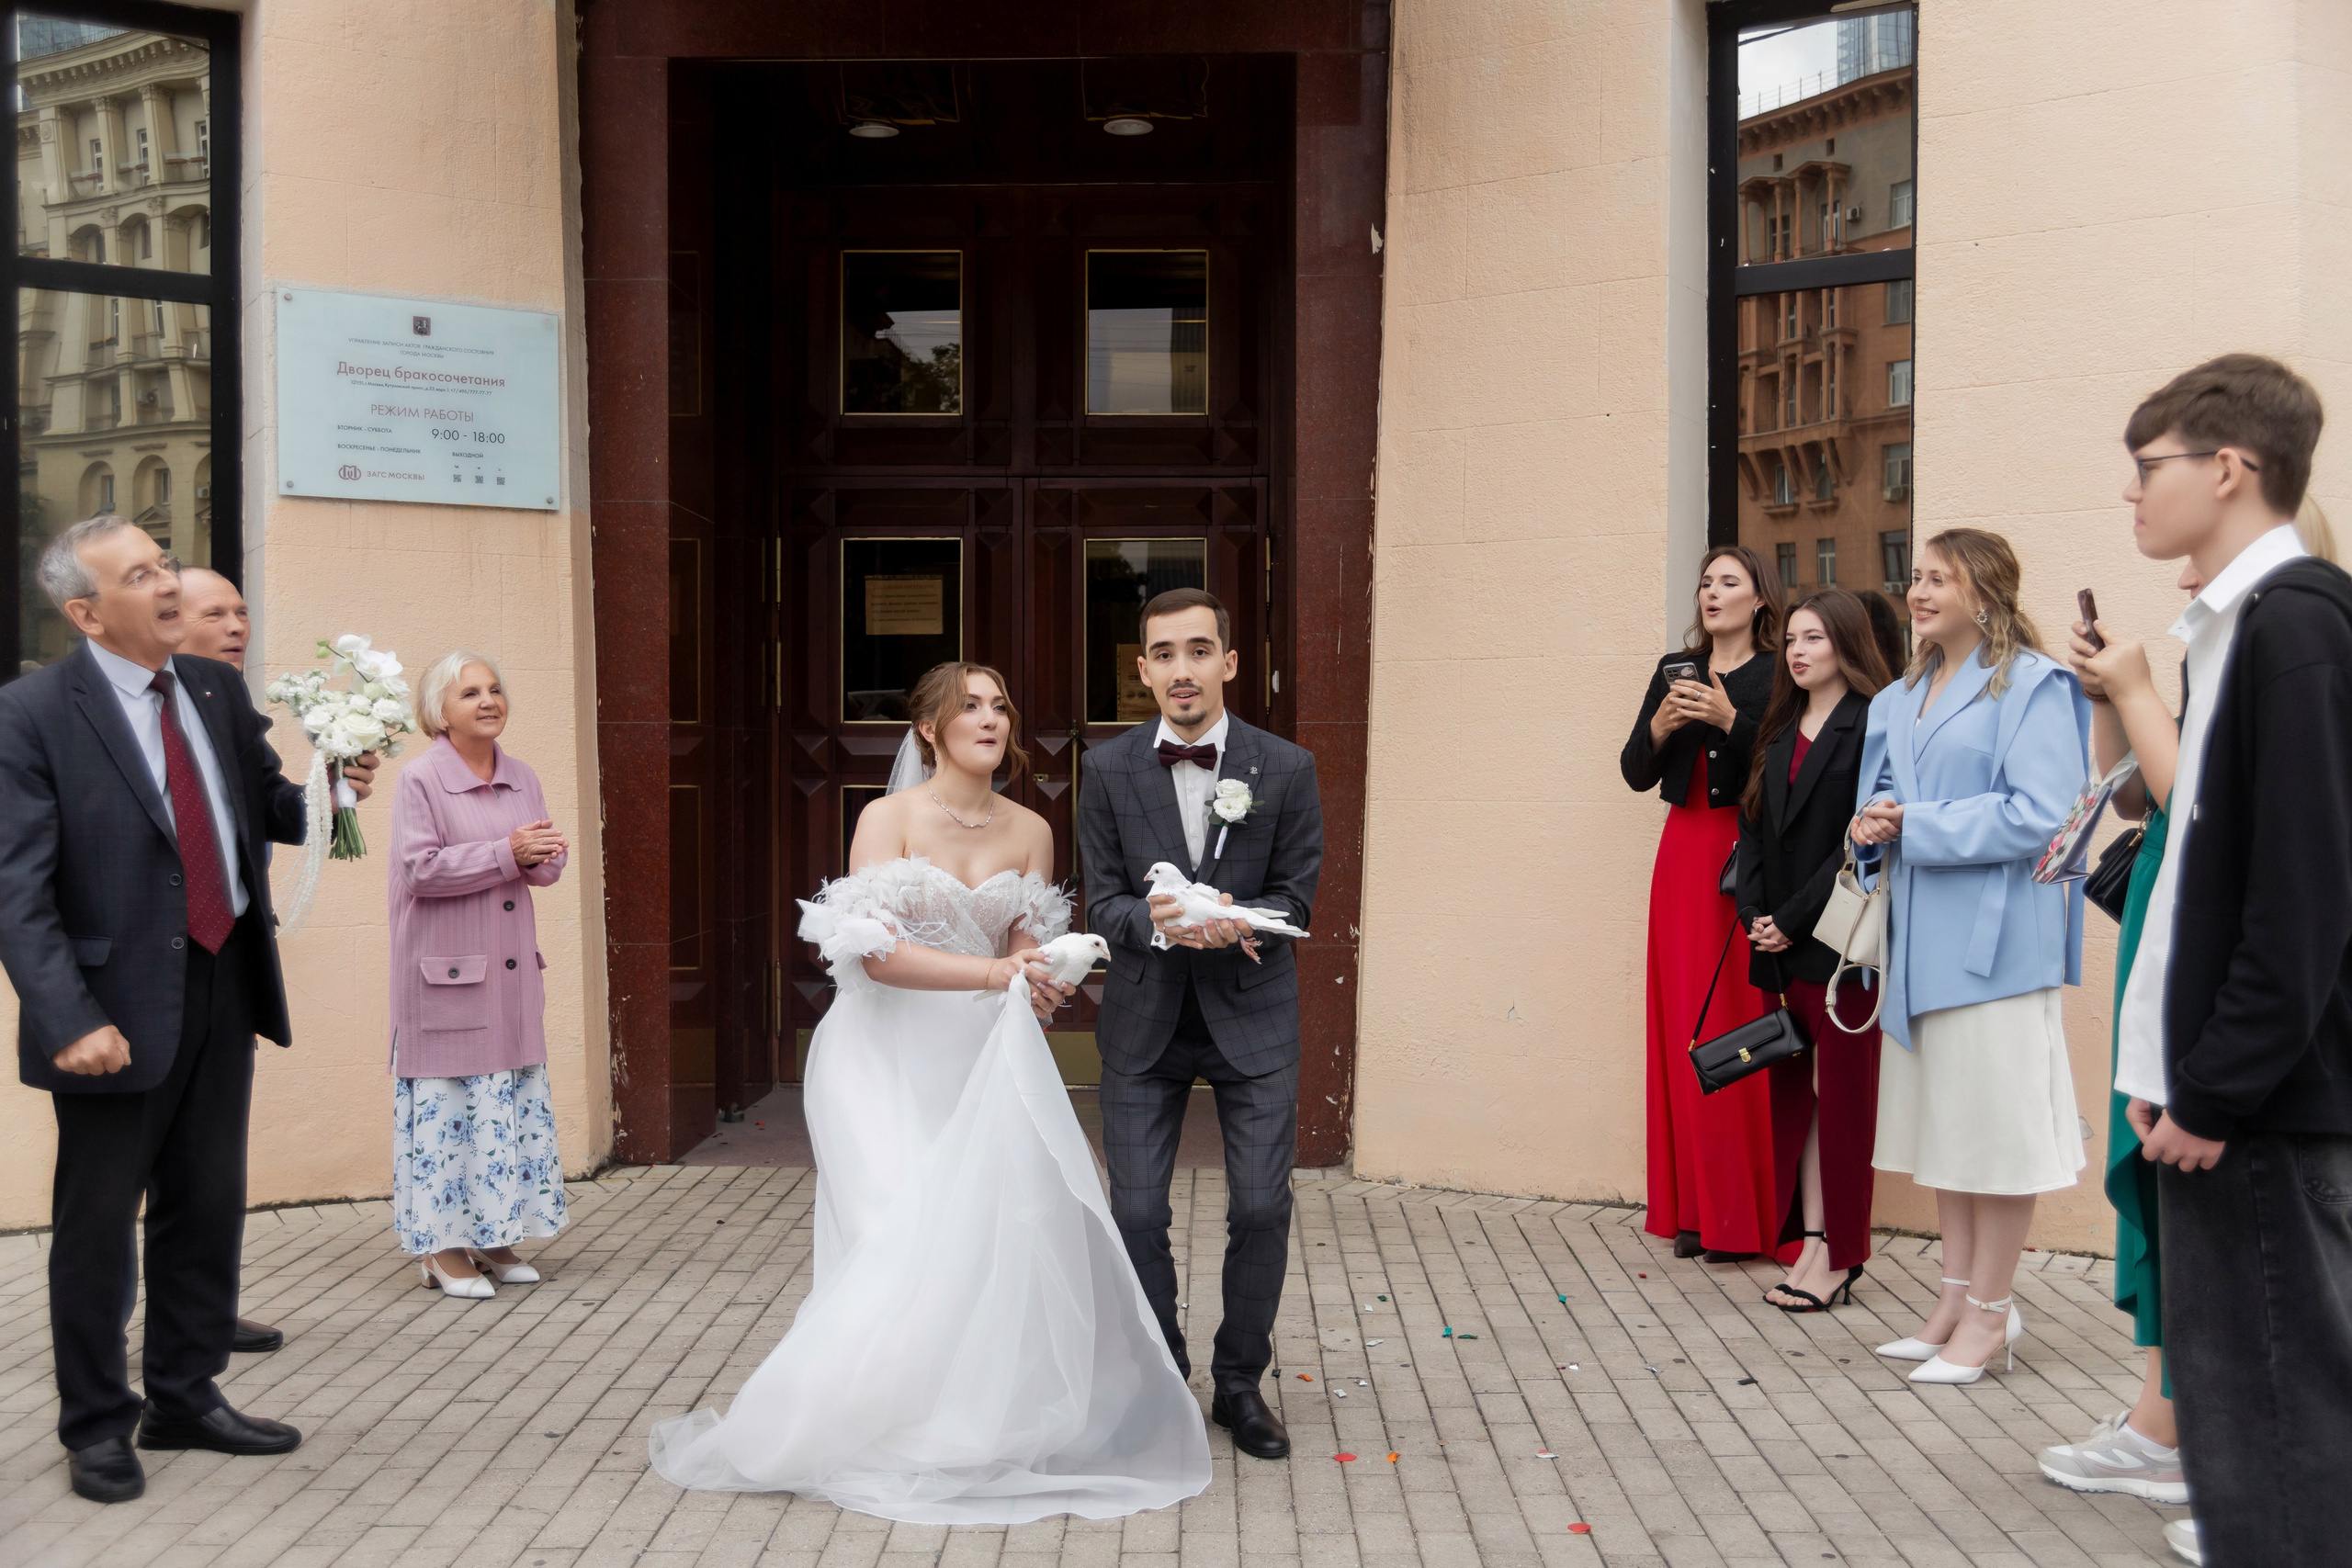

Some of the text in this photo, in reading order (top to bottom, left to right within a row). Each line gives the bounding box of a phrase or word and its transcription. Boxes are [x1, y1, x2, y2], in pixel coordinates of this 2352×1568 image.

[348, 337, 380, 345] УПРАВЛЕНИЕ
[337, 361, 505, 387] Дворец бракосочетания
[371, 404, 474, 422] РЕЖИМ РАБОТЫ
[431, 429, 460, 441] 9:00
[473, 431, 505, 444] 18:00
[388, 472, 425, 480] МОСКВЫ
